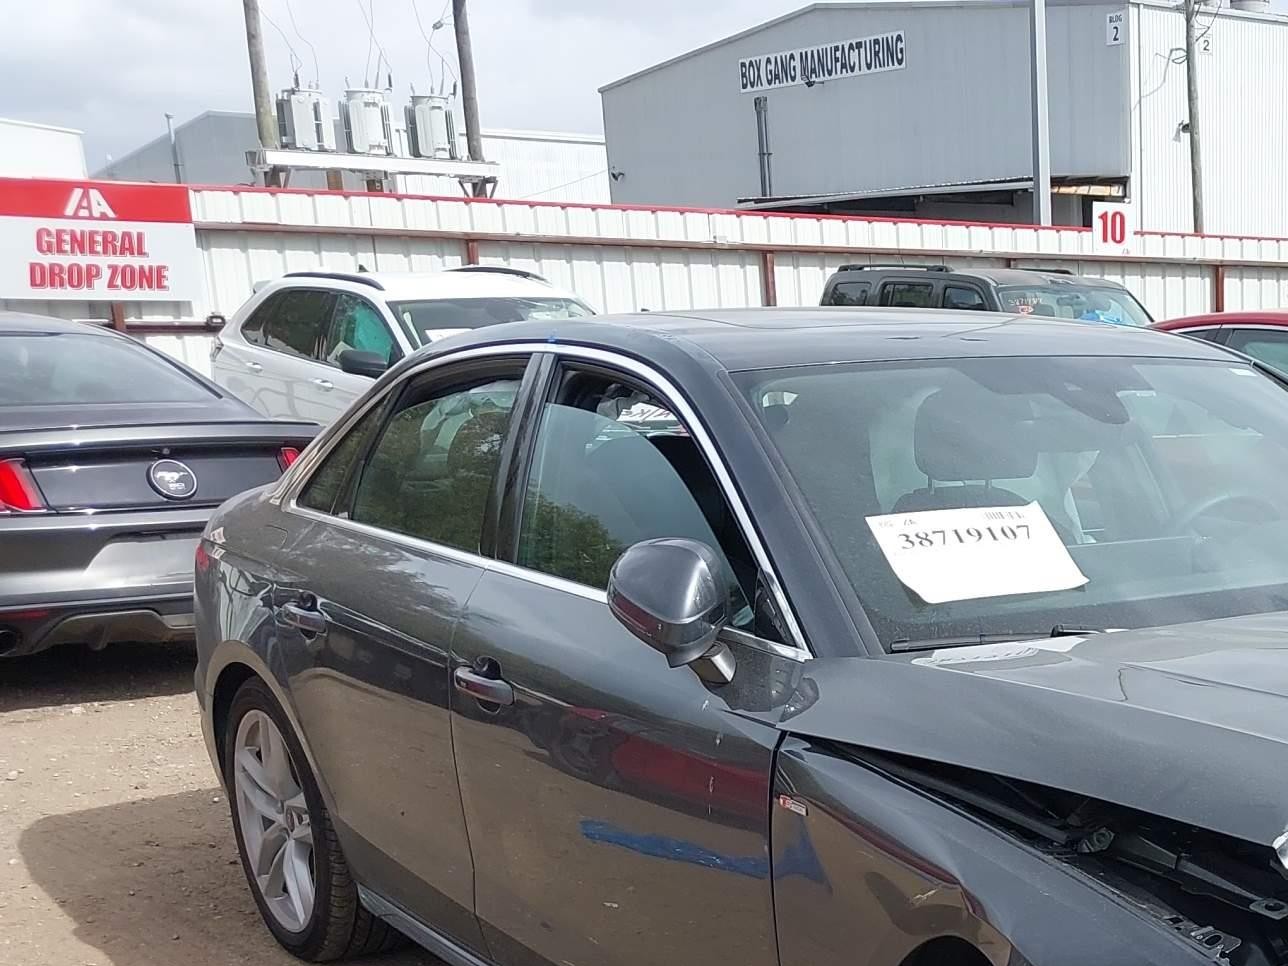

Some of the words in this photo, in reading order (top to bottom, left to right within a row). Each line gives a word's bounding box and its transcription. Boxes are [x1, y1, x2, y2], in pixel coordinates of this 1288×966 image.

[1113, 26, 1119, 41] 2
[1203, 39, 1210, 51] 2
[740, 59, 763, 90] BOX
[765, 53, 797, 86] GANG
[800, 34, 904, 80] MANUFACTURING
[35, 227, 149, 257] GENERAL
[1098, 211, 1125, 244] 10
[29, 262, 102, 290] DROP
[106, 264, 170, 291] ZONE
[898, 524, 1030, 550] 38719107
